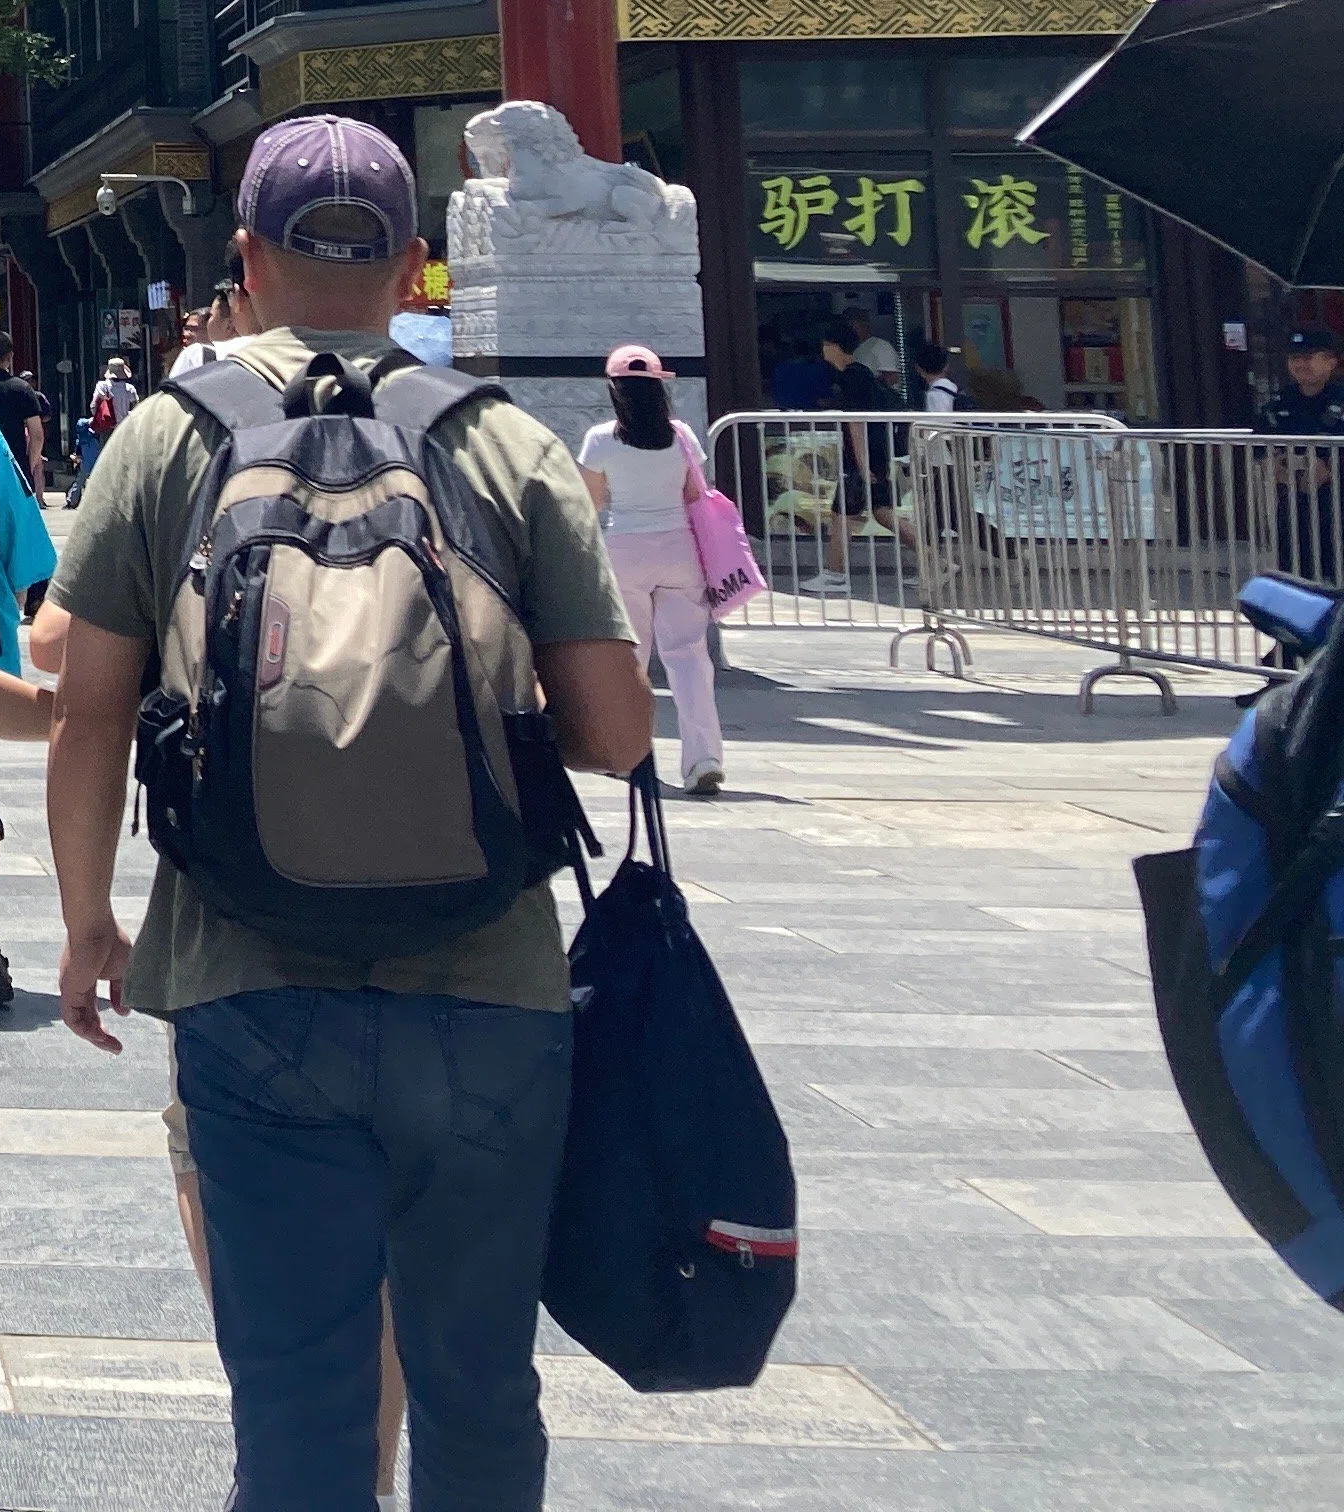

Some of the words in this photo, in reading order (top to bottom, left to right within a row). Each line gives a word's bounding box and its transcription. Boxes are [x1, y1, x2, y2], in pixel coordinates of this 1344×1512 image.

[758, 174, 1051, 250] 驴打滚
[413, 261, 450, 301] 糖
